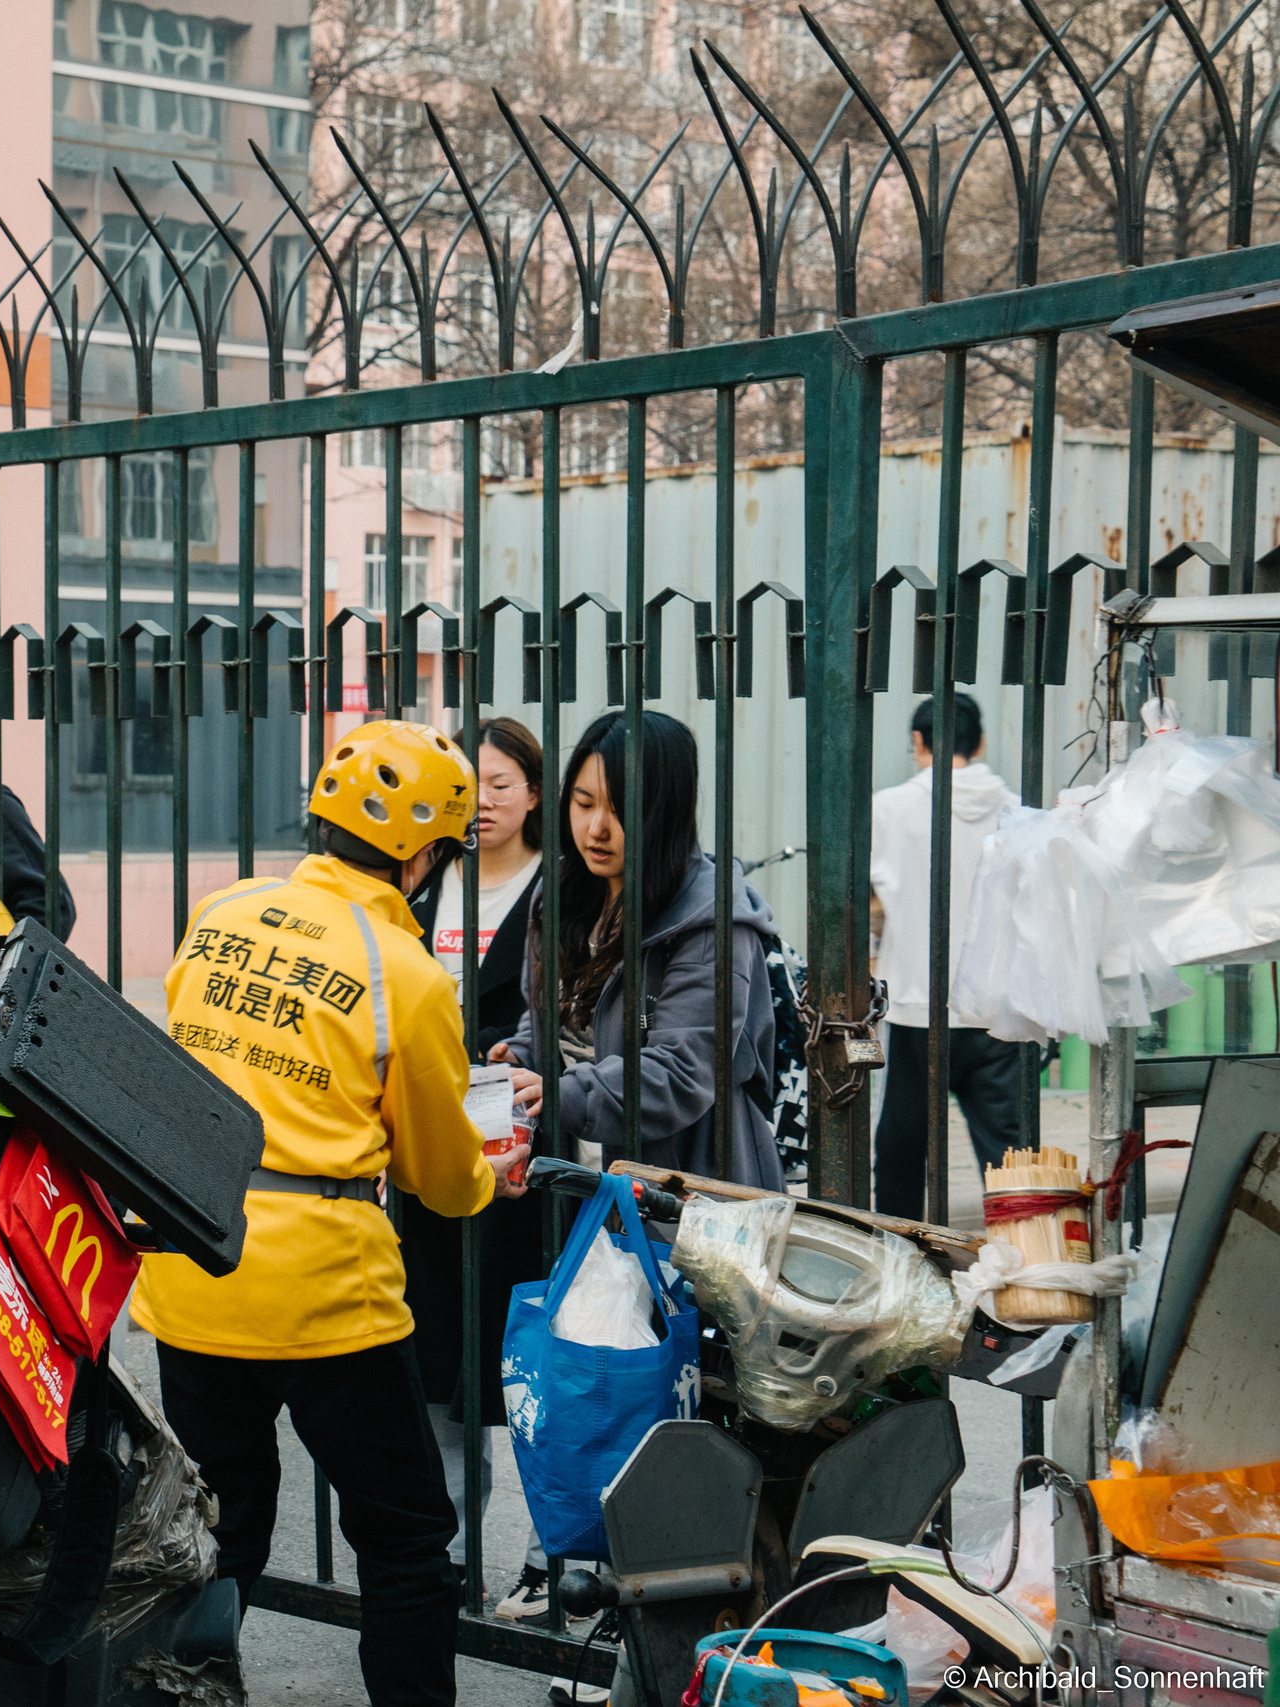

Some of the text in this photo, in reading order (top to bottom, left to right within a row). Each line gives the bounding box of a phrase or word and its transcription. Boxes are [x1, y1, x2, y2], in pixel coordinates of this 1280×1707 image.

[285, 917, 328, 940] 美团
[186, 928, 366, 1016] 买药上美团
[203, 971, 305, 1035] 就是快
[170, 1021, 332, 1091] 美团配送 准时好用
